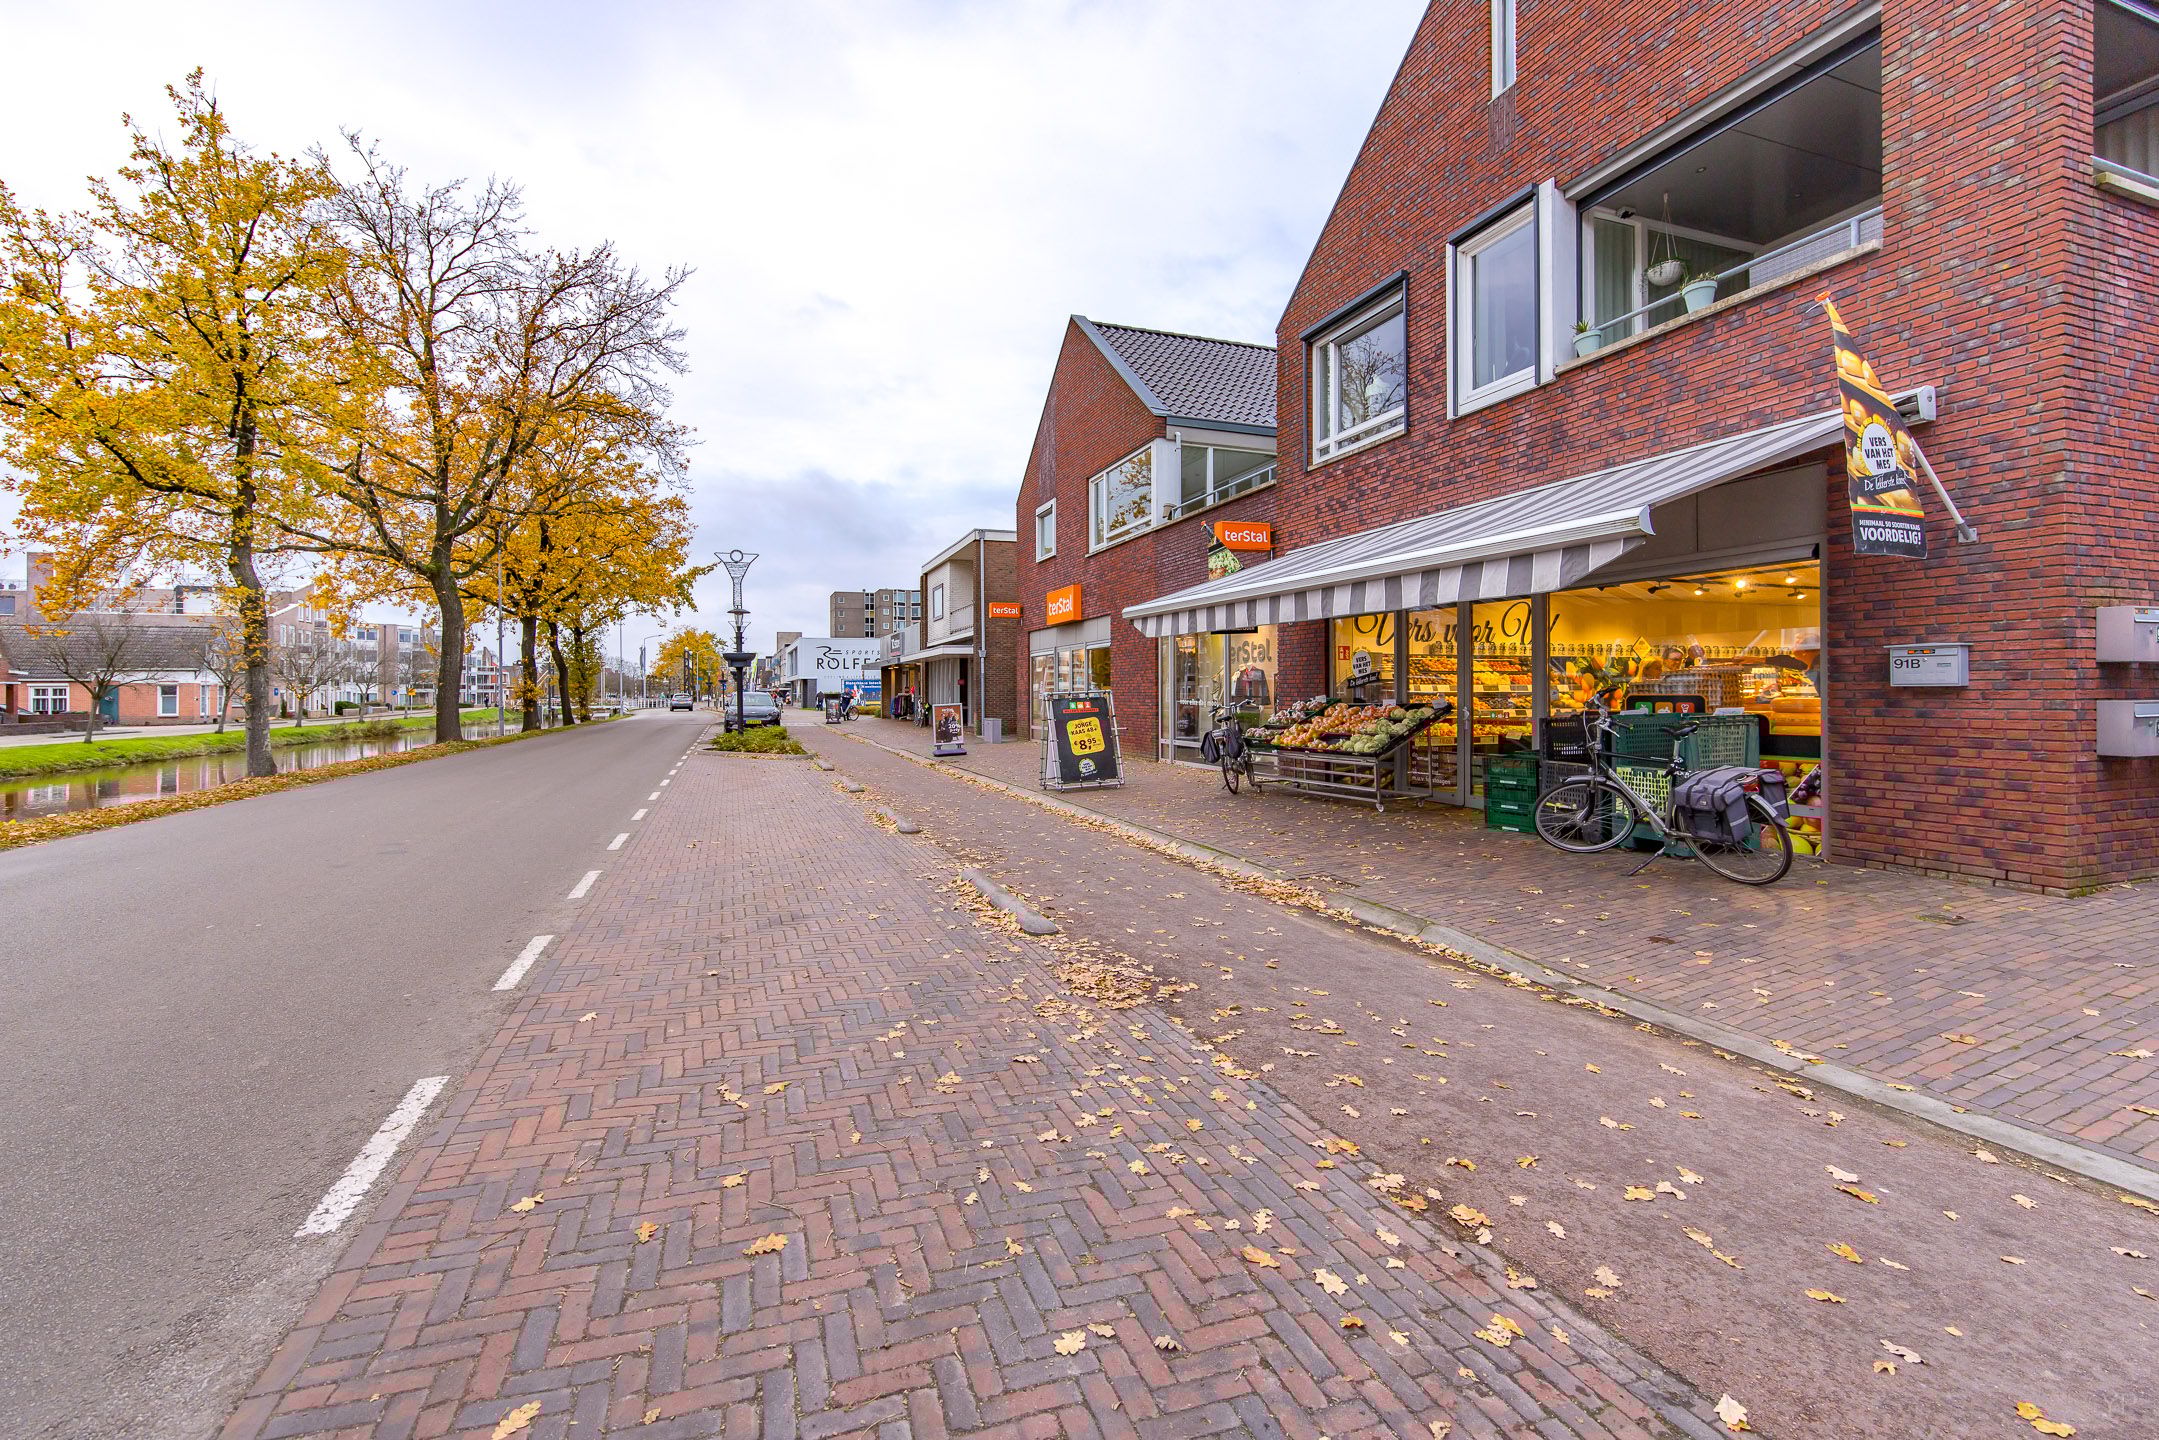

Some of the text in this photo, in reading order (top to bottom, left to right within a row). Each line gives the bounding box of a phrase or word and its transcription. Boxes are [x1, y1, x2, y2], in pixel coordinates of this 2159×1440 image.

[1869, 437, 1887, 447] VERS
[1865, 448, 1894, 459] VAN HET
[1876, 459, 1891, 470] MES
[1864, 479, 1874, 491] De
[1859, 519, 1885, 527] MINIMAAL
[1224, 529, 1268, 543] terStal
[1860, 526, 1922, 545] VOORDELIG!
[993, 606, 1019, 615] terStal
[1048, 594, 1073, 617] terStal
[1443, 620, 1496, 643] vor
[1230, 637, 1272, 664] erStal
[1355, 655, 1368, 663] VERS
[1893, 658, 1921, 669] 91B
[1074, 721, 1093, 729] JONGE
